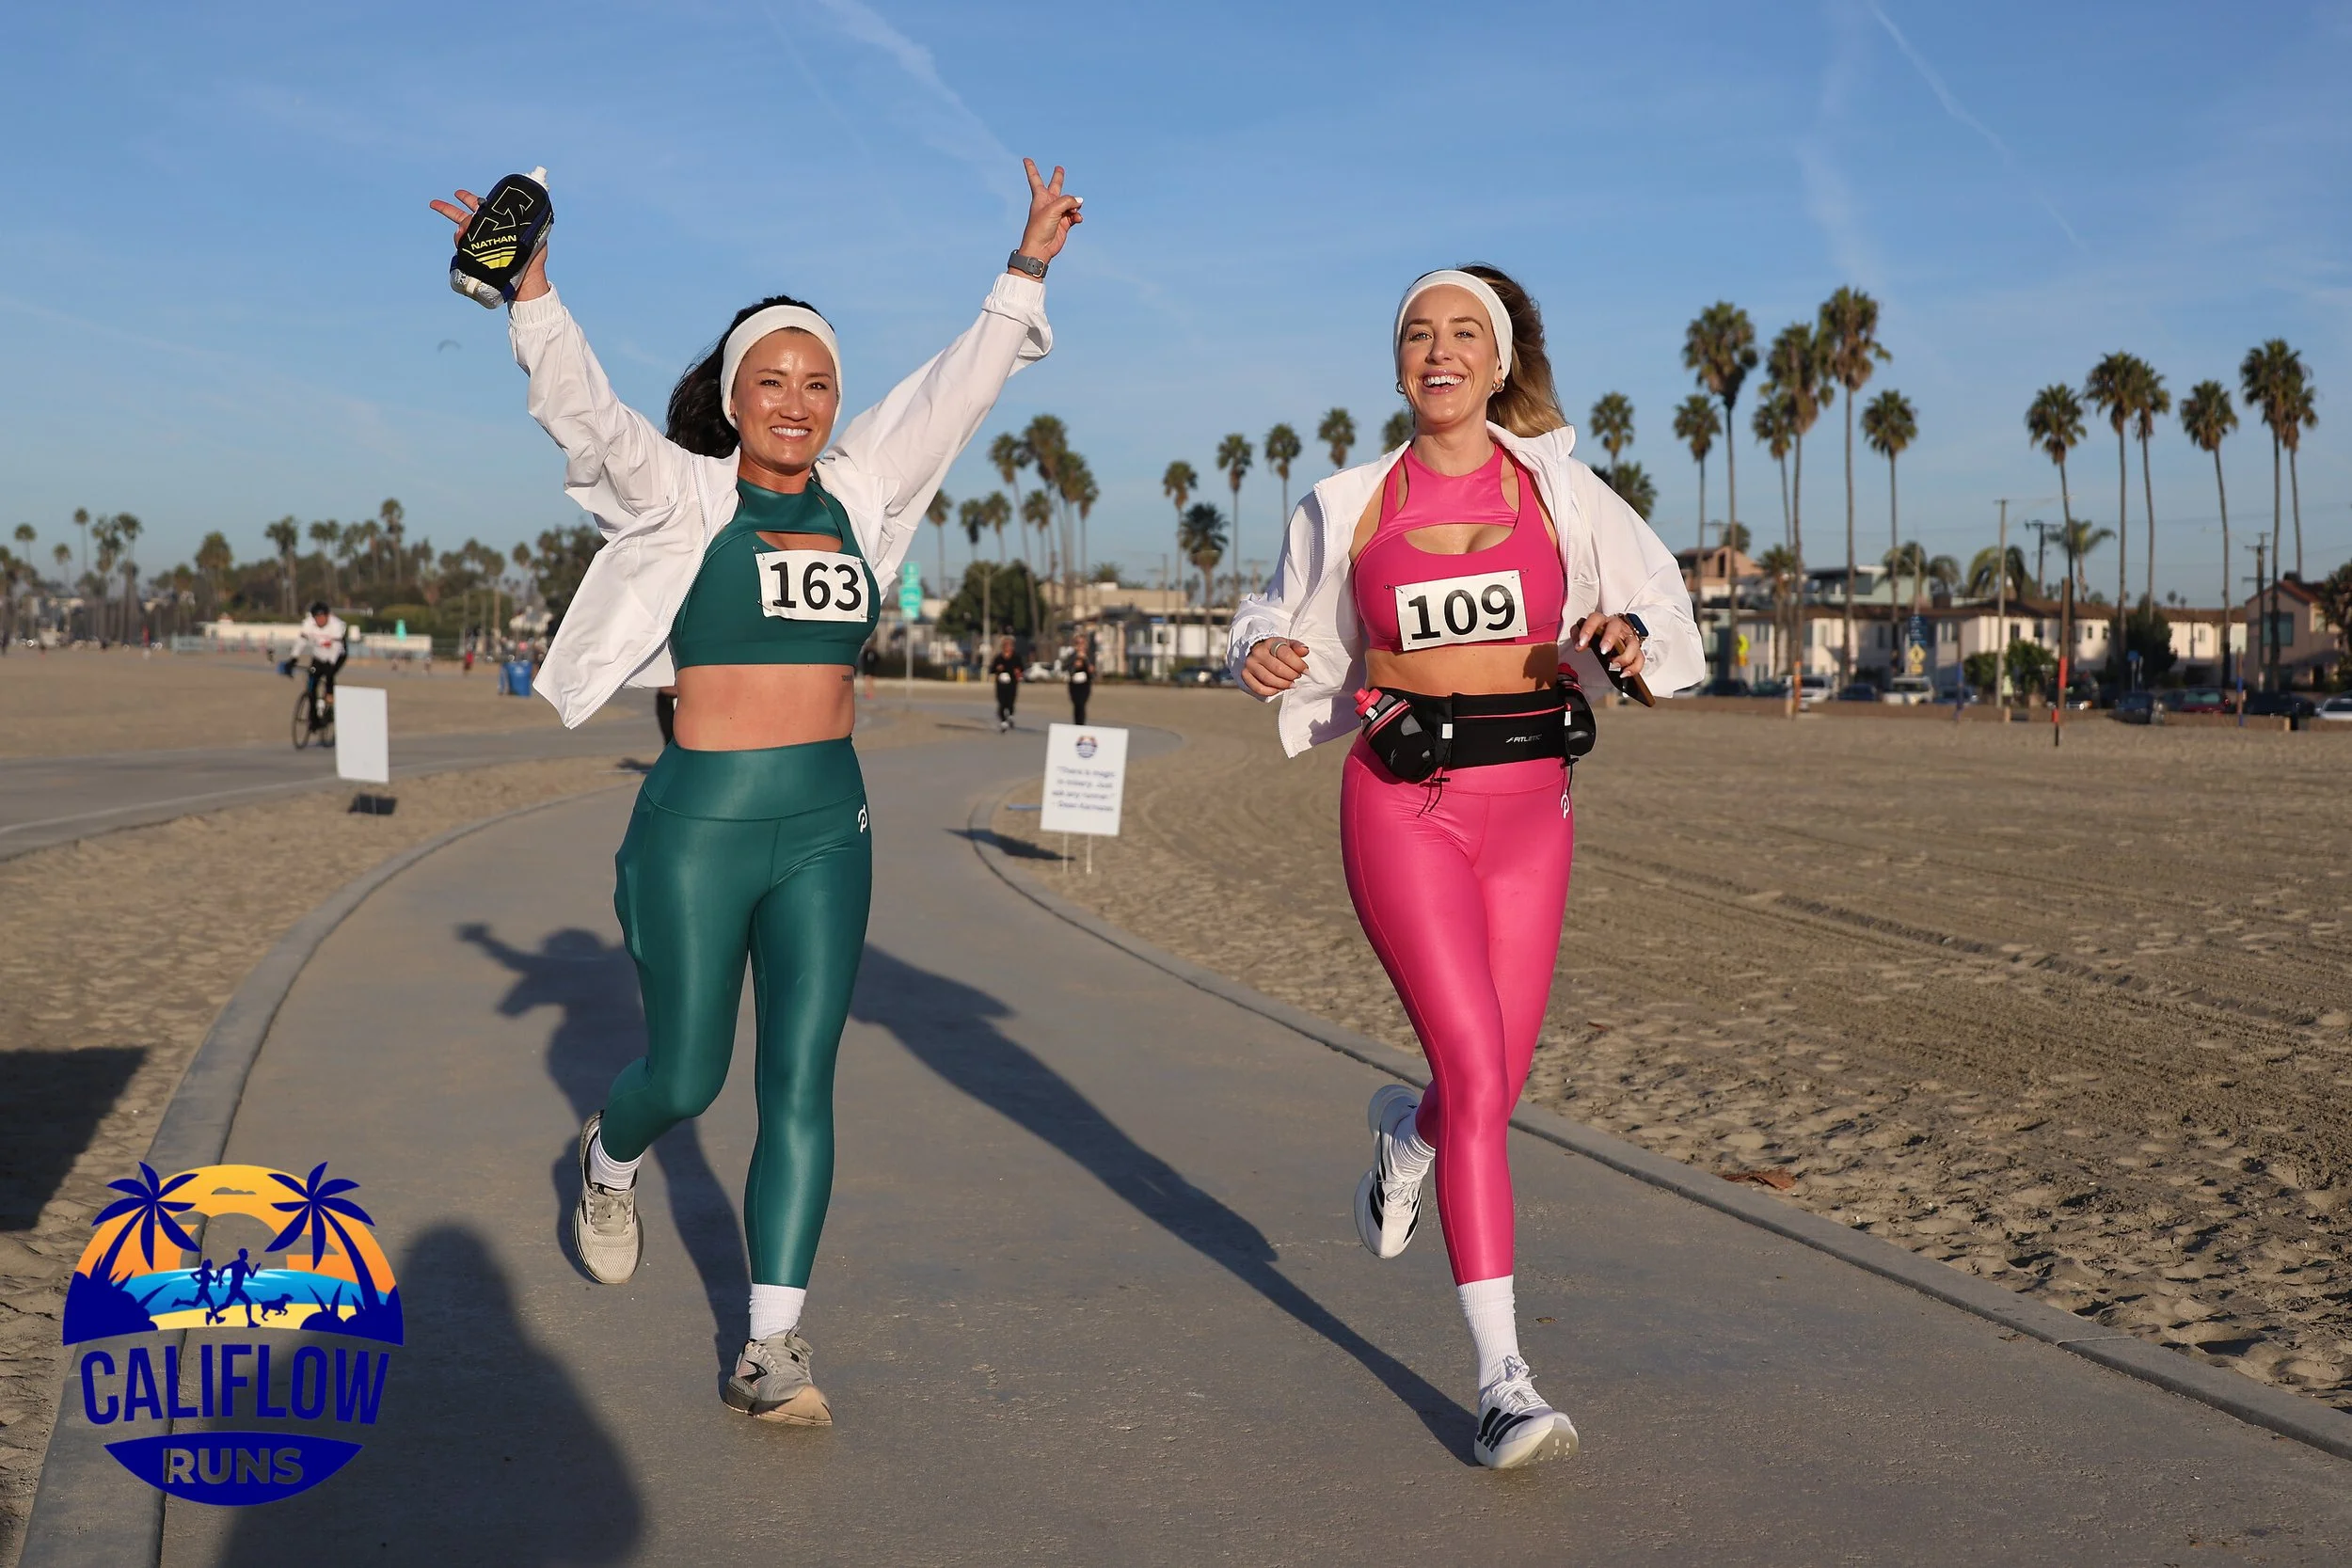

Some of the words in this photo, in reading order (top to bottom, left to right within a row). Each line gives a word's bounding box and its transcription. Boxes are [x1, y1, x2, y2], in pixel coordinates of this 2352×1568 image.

[470, 235, 516, 250] NATHAN
[770, 561, 862, 611] 163
[1407, 583, 1516, 641] 109
